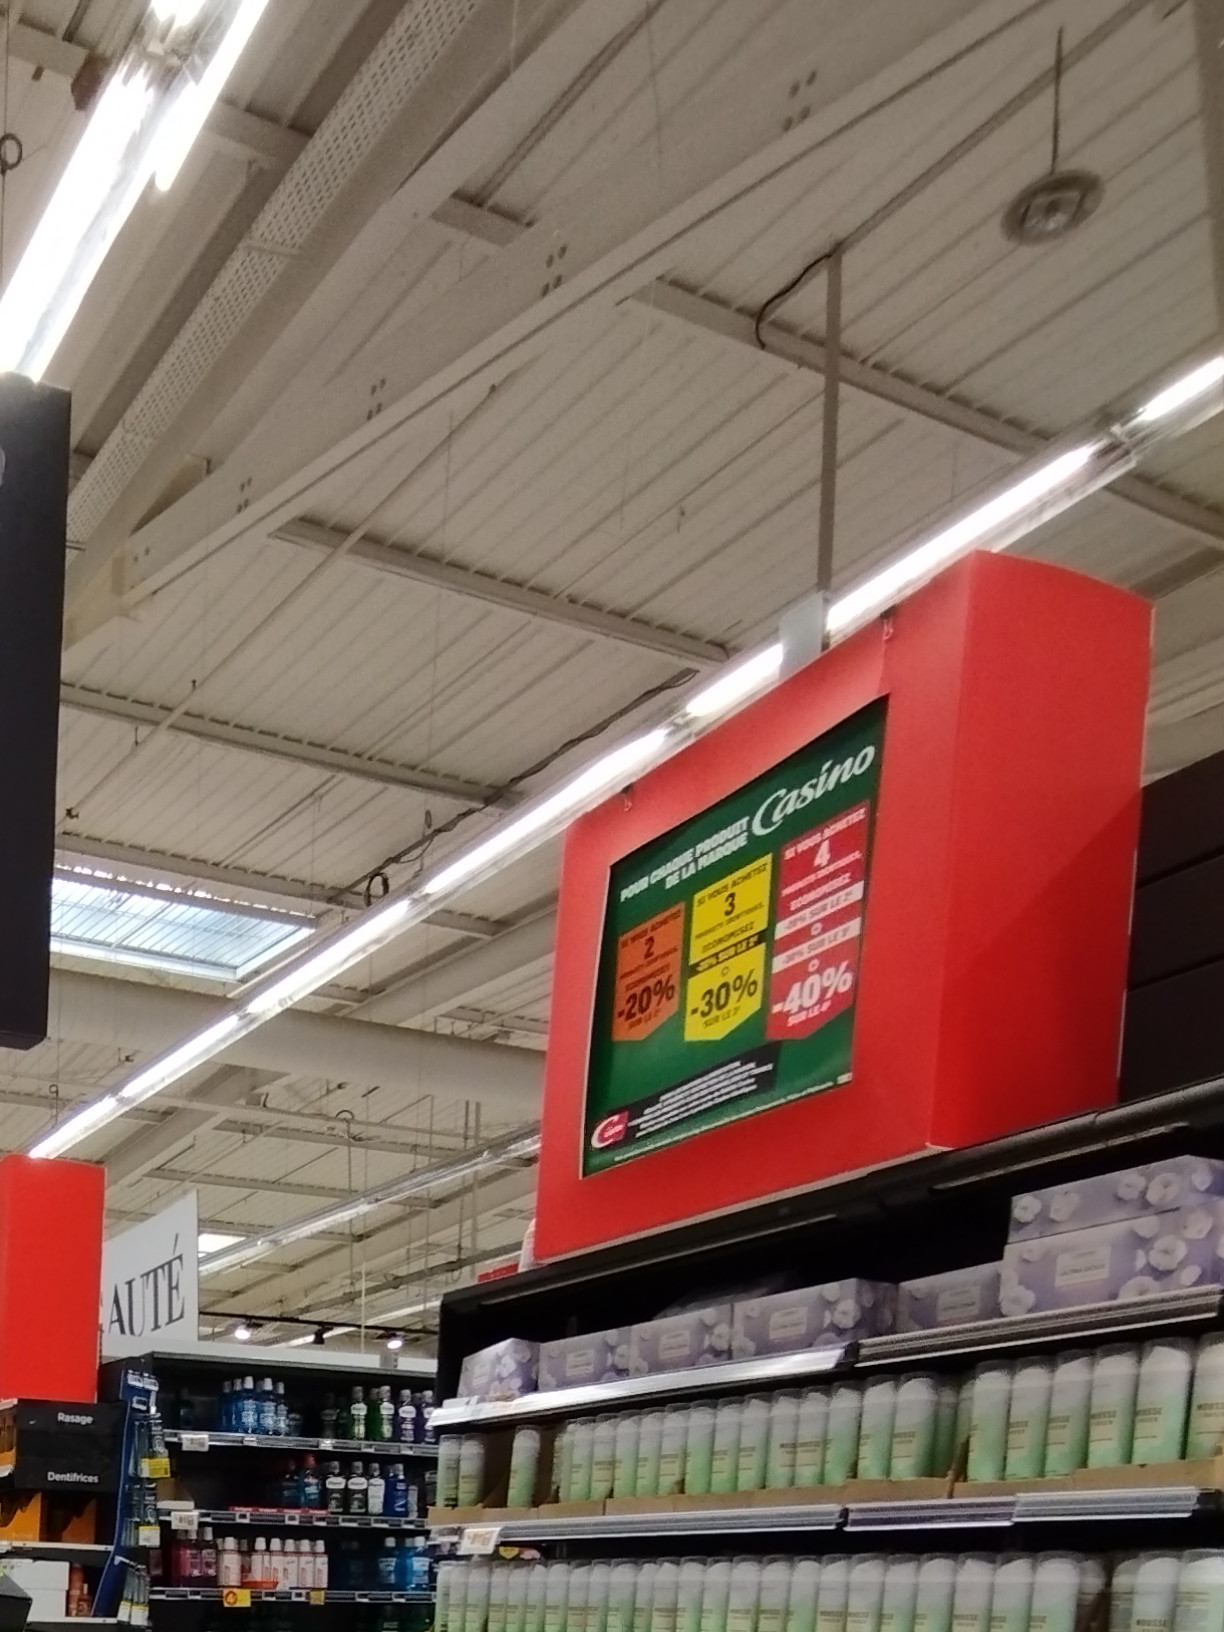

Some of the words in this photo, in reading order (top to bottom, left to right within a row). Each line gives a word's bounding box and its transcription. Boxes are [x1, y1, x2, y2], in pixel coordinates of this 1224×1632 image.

[752, 745, 875, 838] Casino
[620, 876, 649, 903] POUR
[650, 848, 695, 885] CHAQUE
[696, 816, 750, 857] PRODUIT
[665, 874, 680, 889] DE
[682, 864, 696, 880] LA
[697, 832, 749, 871] MARQUE
[813, 839, 831, 867] 4
[724, 892, 736, 917] 3
[644, 936, 655, 959] 2
[618, 974, 675, 1021] -20%
[691, 968, 757, 1018] -30%
[772, 960, 853, 1014] -40%
[57, 1412, 94, 1425] Rasage
[47, 1471, 99, 1483] Dentifrices
